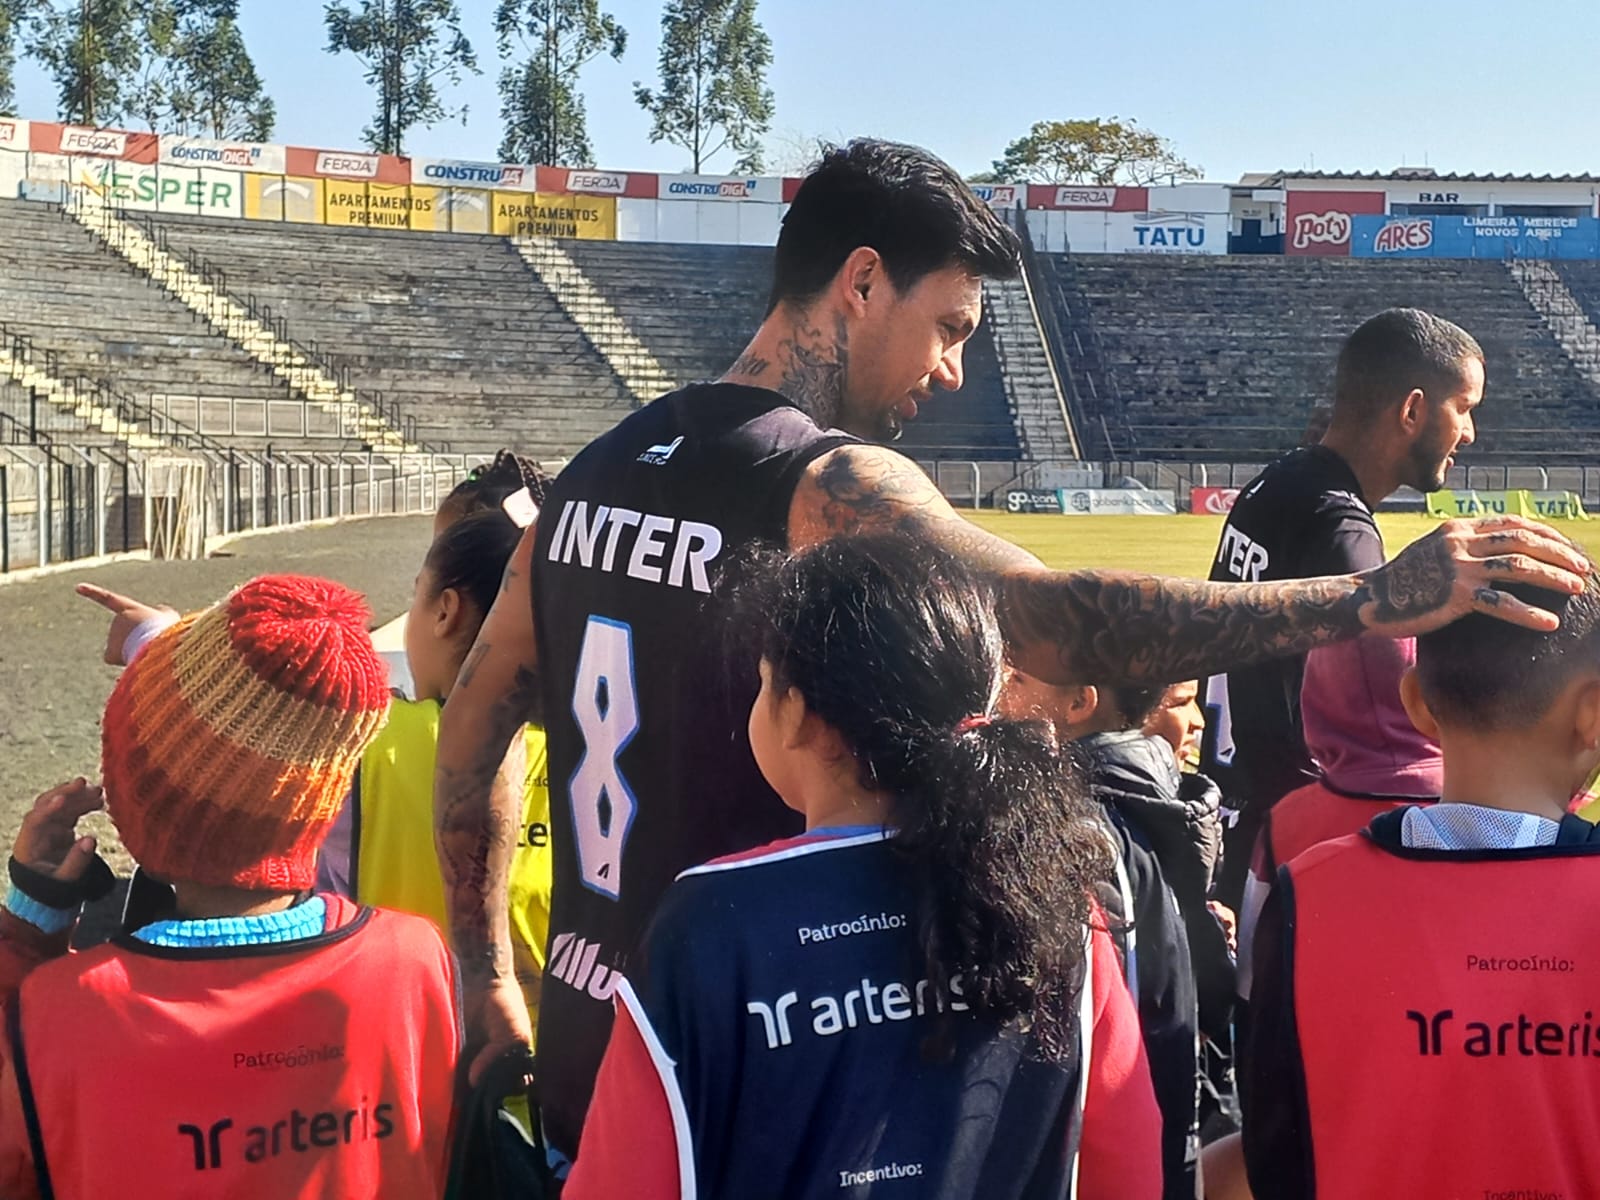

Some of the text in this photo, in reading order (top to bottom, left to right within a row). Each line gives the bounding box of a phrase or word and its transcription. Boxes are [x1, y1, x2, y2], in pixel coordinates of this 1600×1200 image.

[321, 157, 372, 173] FERJA
[572, 175, 621, 190] FERJA
[329, 193, 432, 212] APARTAMENTOS
[1062, 191, 1109, 204] FERJA
[1418, 193, 1459, 203] BAR
[349, 211, 409, 226] PREMIUM
[499, 205, 599, 222] APARTAMENTOS
[518, 221, 577, 236] PREMIUM
[1463, 217, 1577, 228] LIMEIRA MERECE
[1133, 226, 1205, 247] TATU
[1375, 220, 1432, 251] ARES
[1475, 228, 1519, 237] NOVOS
[1454, 500, 1505, 514] TATU
[547, 500, 723, 594] INTER
[1218, 523, 1269, 582] TER
[569, 614, 640, 901] 8
[798, 912, 907, 945] Patrocínio:
[1466, 954, 1575, 972] Patrocínio:
[1463, 1010, 1600, 1057] arteri
[244, 1095, 395, 1164] arteris
